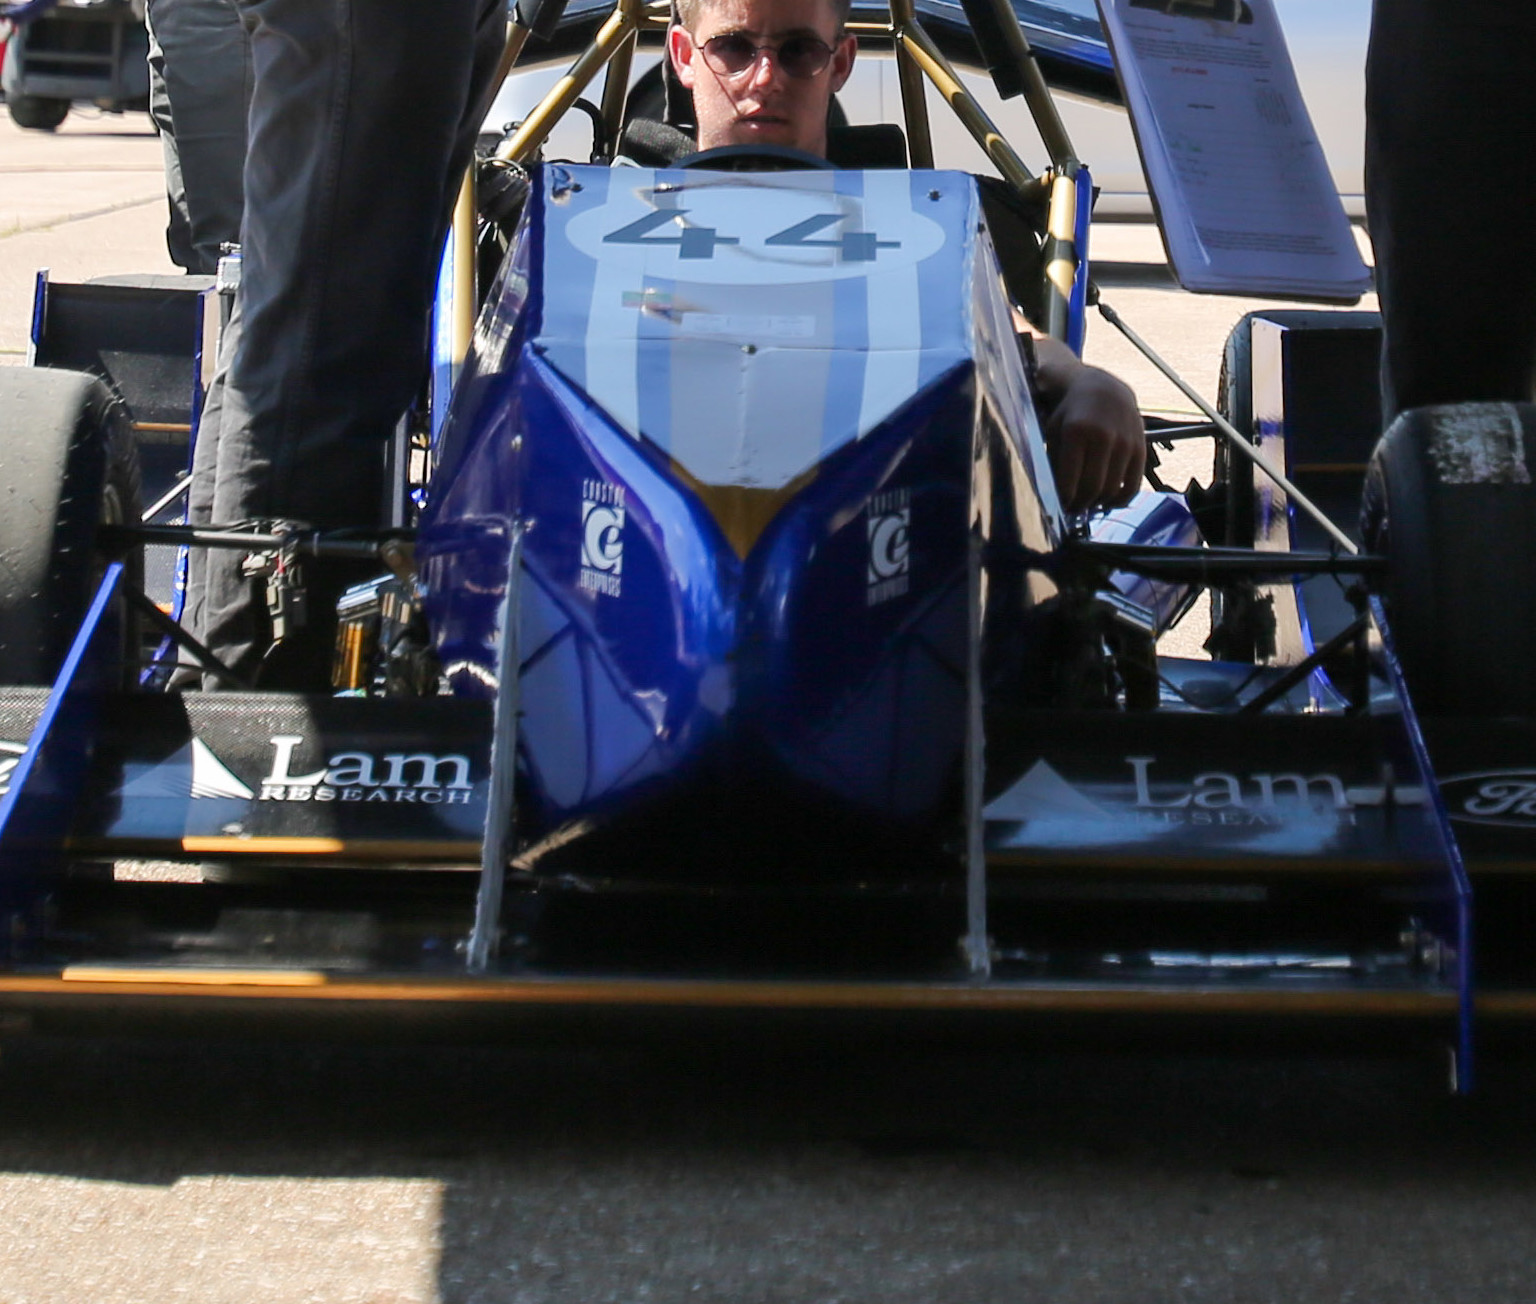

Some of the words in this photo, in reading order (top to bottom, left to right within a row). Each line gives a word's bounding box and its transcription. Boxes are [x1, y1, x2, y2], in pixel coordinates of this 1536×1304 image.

[602, 208, 902, 260] 44
[264, 736, 472, 788] Lam
[1125, 756, 1353, 809] Lam
[258, 785, 473, 805] RESEARCH
